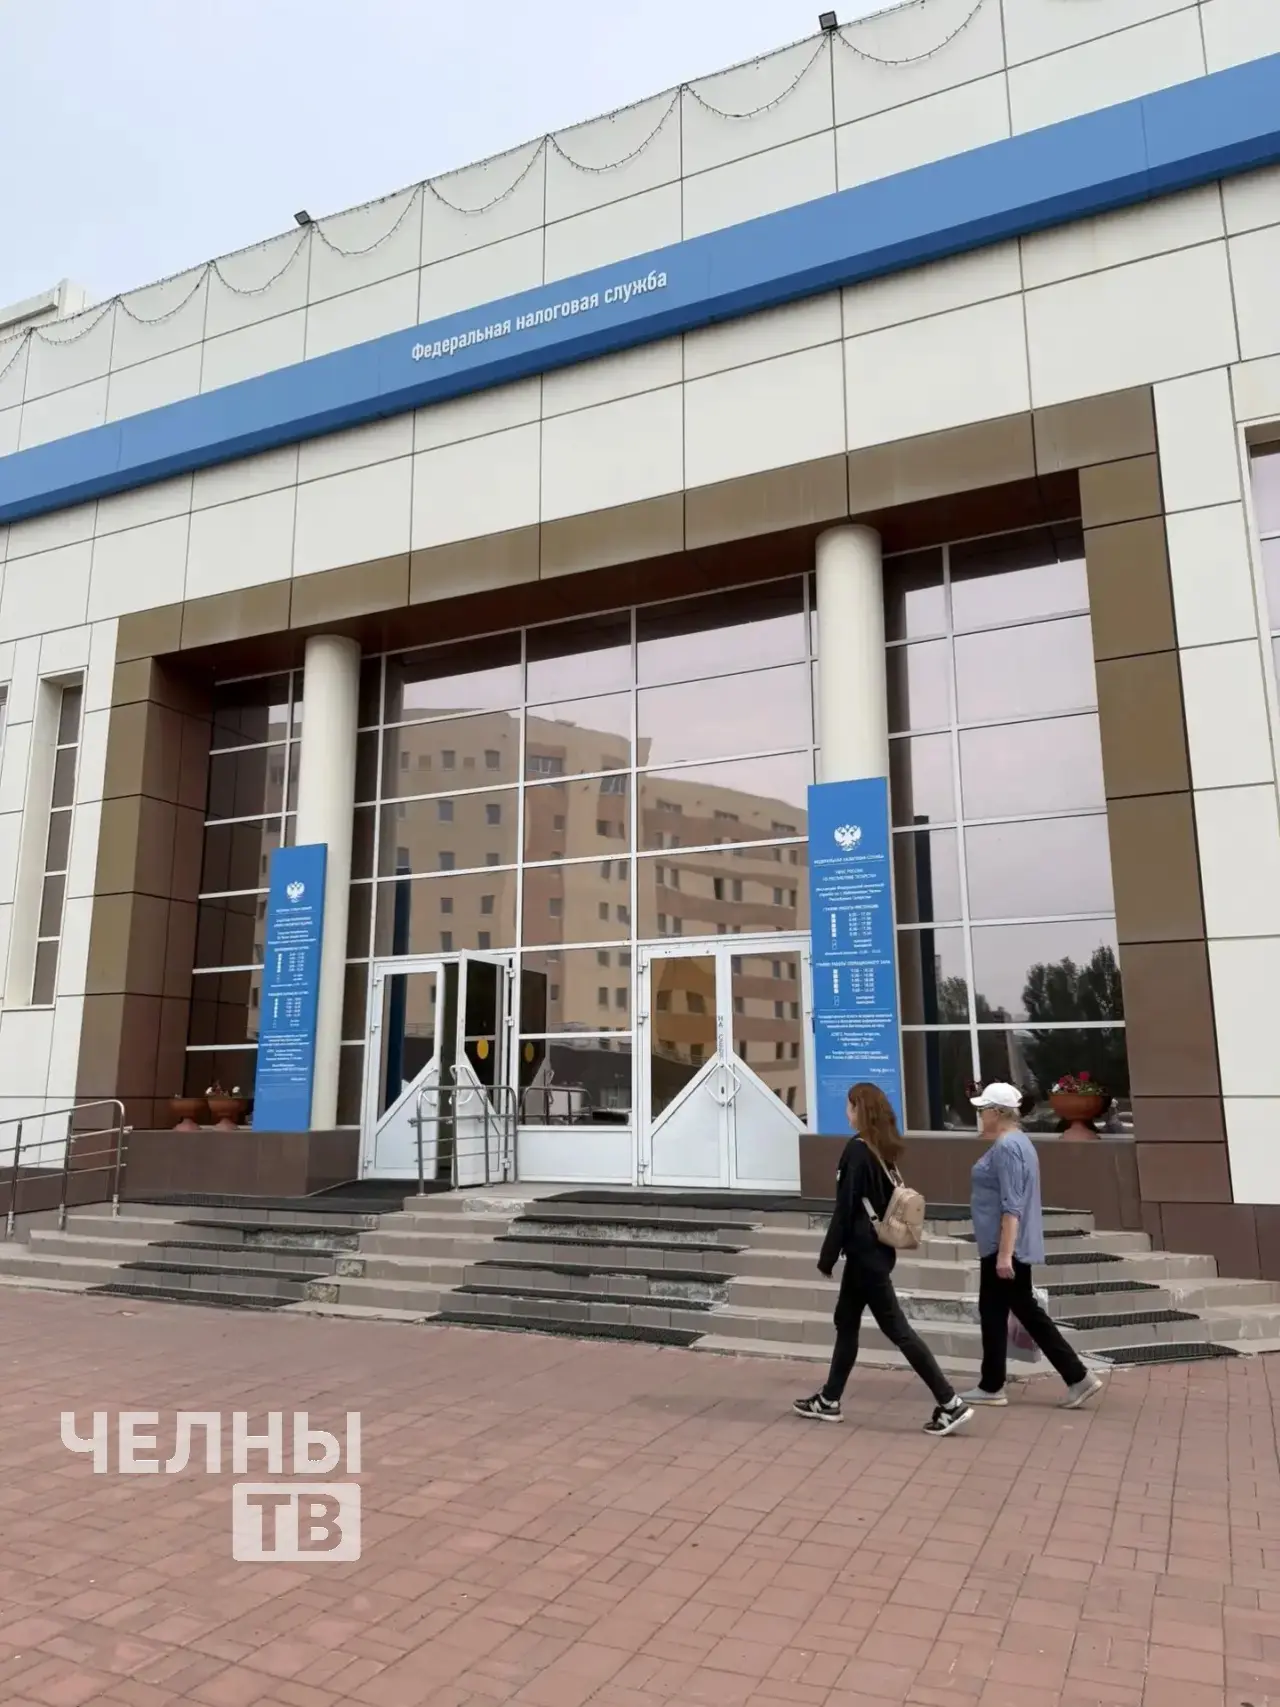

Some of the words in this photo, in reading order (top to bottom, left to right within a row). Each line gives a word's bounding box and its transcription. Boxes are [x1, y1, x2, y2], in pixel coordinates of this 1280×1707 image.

[411, 319, 511, 361] Федеральная
[516, 292, 599, 331] налоговая
[604, 270, 667, 304] служба
